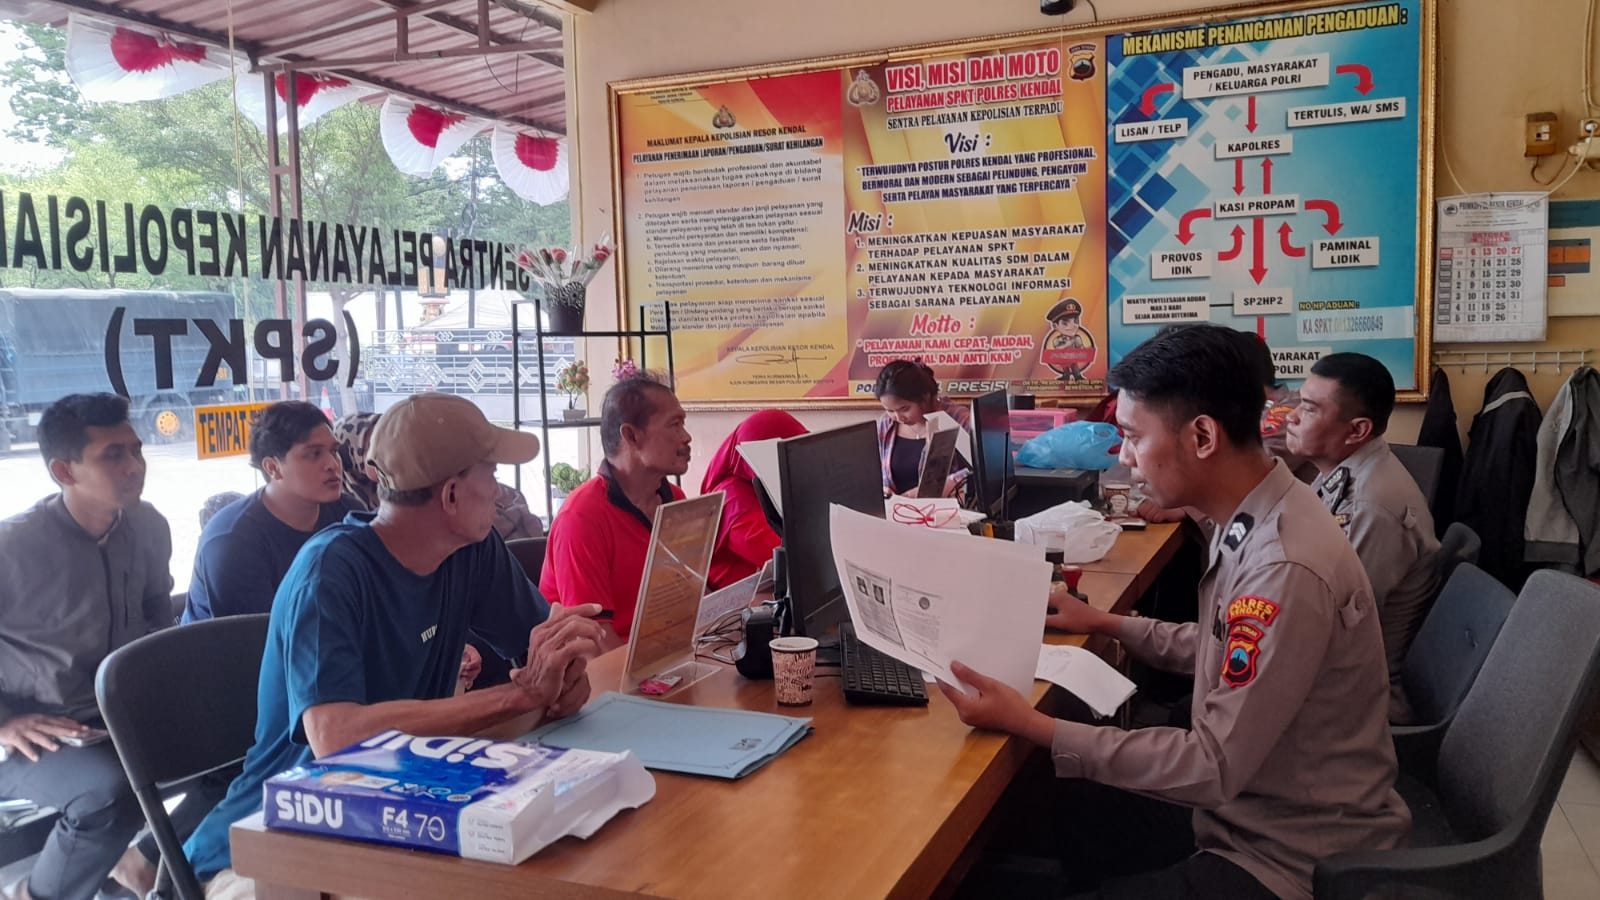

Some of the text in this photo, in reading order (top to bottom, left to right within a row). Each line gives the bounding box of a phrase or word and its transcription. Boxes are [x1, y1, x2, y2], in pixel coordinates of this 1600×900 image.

[1122, 4, 1399, 56] MEKANISME PENANGANAN PENGADUAN
[887, 50, 1059, 90] VISI, MISI DAN MOTO
[1193, 58, 1318, 80] PENGADU, MASYARAKAT
[1216, 74, 1301, 91] KELUARGA POLRI
[888, 80, 1062, 111] PELAYANAN SPKT POLRES KENDAL
[888, 102, 1062, 129] SENTRA PELAYANAN KEPOLISIAN TERPADU
[1294, 102, 1399, 120] TERTULIS, WA/ SMS
[647, 125, 806, 147] MAKLUMAT KEPALA KEPOLISIAN RESOR KENDAL
[1121, 123, 1182, 137] LISAN TELP
[633, 153, 663, 163] PELAYANAN
[664, 150, 699, 160] PENERIMAAN
[786, 138, 823, 150] KEHILANGAN
[945, 132, 979, 153] Visi
[1228, 140, 1280, 153] KAPOLRES
[861, 163, 916, 176] TERWUJUDNYA
[918, 160, 950, 172] POSTUR
[951, 157, 980, 170] POLRES
[982, 154, 1012, 167] KENDAL
[1014, 152, 1035, 164] YANG
[862, 177, 902, 190] BERMORAL
[904, 176, 920, 187] DAN
[922, 174, 955, 186] MODERN
[956, 171, 990, 184] SEBAGAI
[1041, 163, 1086, 176] PENGAYOM
[883, 179, 1070, 202] SERTA PELAYAN MASYARAKAT YANG TERPERCAYA
[1219, 199, 1295, 213] KASI PROPAM
[848, 212, 881, 232] Misi
[856, 224, 1085, 247] 1. MENINGKATKAN KEPUASAN MASYARAKAT
[868, 242, 1015, 259] TERHADAP PELAYANAN SPKT
[1319, 240, 1371, 251] PAMINAL
[1496, 247, 1507, 255] 20
[1511, 246, 1521, 254] 27
[856, 252, 1070, 272] 2. MENINGKATKAN KUALITAS SDM DALAM
[1161, 252, 1202, 263] PROVOS
[1331, 254, 1360, 265] LIDIK
[1483, 259, 1491, 267] 14
[868, 267, 1045, 284] PELAYANAN KEPADA MASYARAKAT
[1171, 265, 1192, 275] IDIK
[1482, 270, 1491, 278] 15
[857, 279, 1070, 297] 3. TERWUJUDNYA TEKNOLOGI INFORMASI
[1510, 280, 1521, 288] 30
[869, 295, 1020, 309] SEBAGAI SARANA PELAYANAN
[1243, 296, 1283, 306] SP2HP2
[1510, 291, 1520, 299] 31
[911, 313, 961, 334] Motto
[864, 340, 922, 350] PELAYANAN
[925, 339, 950, 349] KAMI
[939, 353, 960, 364] DAN
[963, 353, 987, 363] ANTI
[990, 351, 1012, 362] KKN
[1272, 351, 1320, 361] YARAKAT
[947, 381, 1009, 392] PRESISI
[198, 410, 247, 455] TEMPAT
[1230, 598, 1274, 615] POLRES
[275, 790, 343, 829] SiDU
[383, 806, 409, 829] F4
[414, 813, 445, 841] 70
